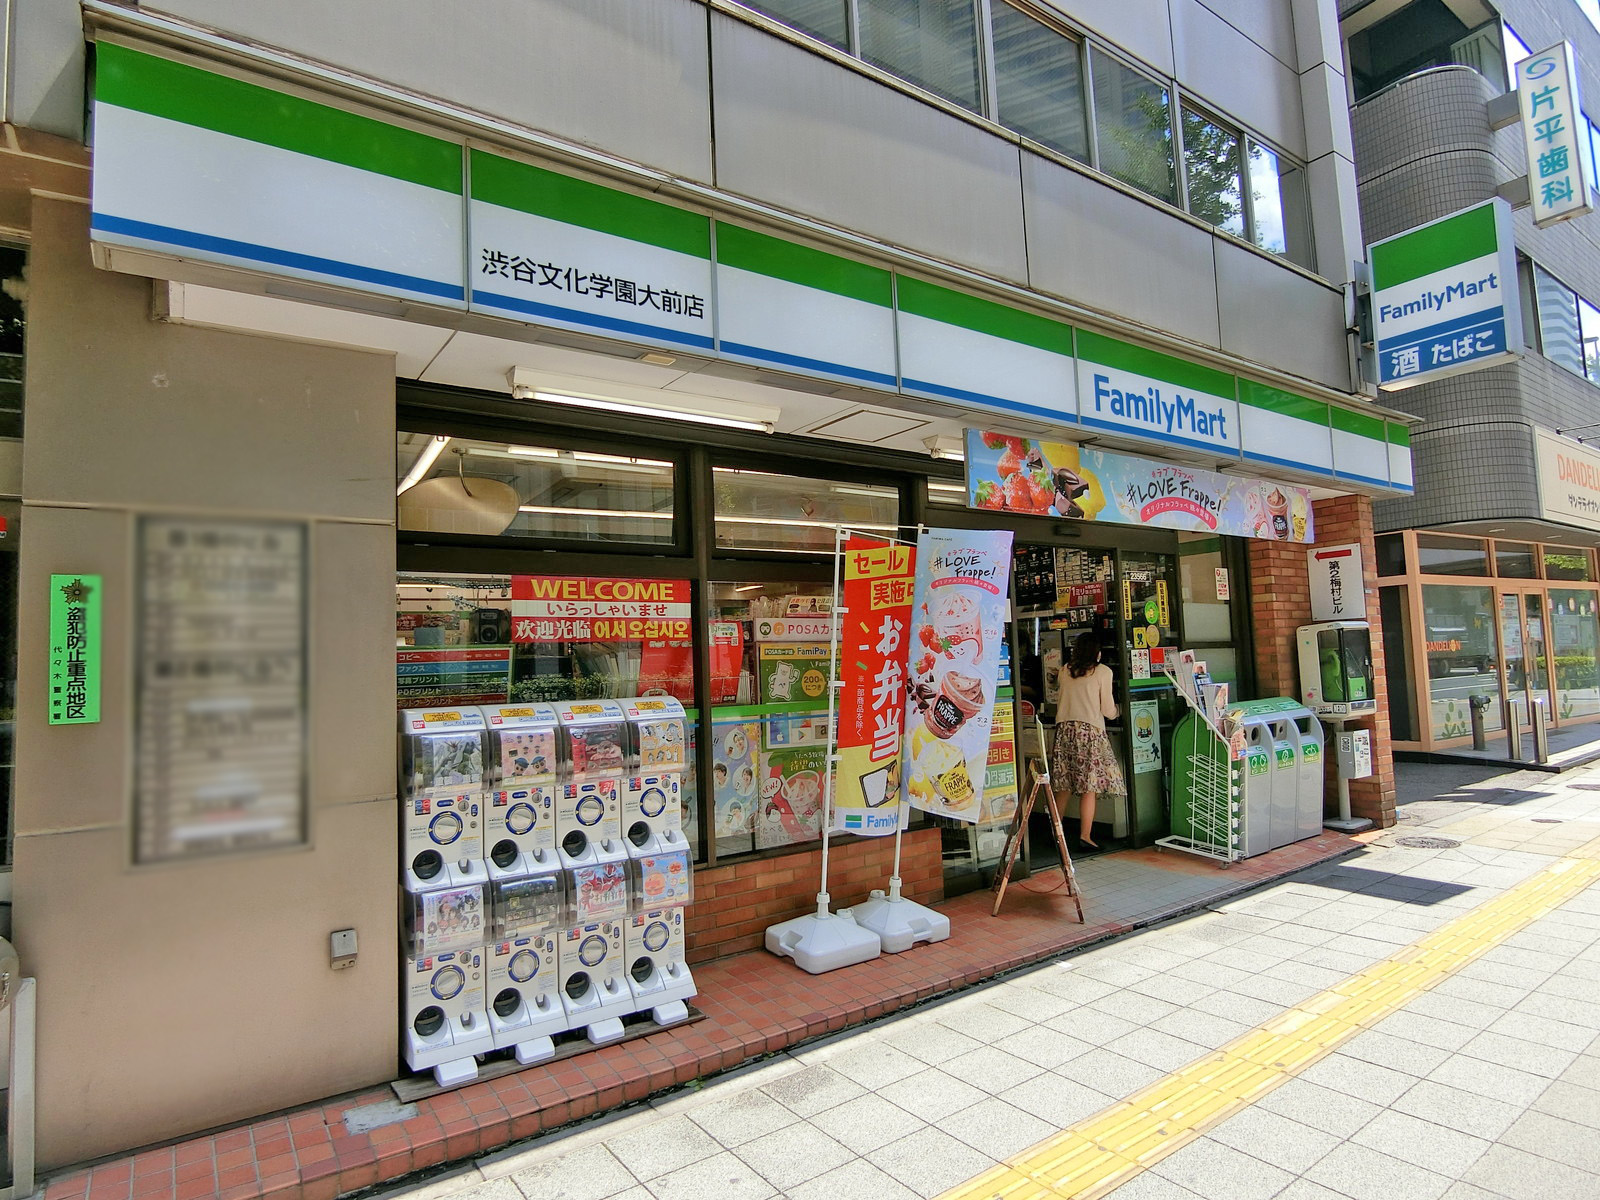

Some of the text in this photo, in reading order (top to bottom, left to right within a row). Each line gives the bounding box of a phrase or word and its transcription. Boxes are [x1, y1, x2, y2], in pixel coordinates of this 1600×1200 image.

[1530, 85, 1574, 209] 片平歯科
[481, 248, 704, 320] 渋谷文化学園大前店
[1379, 272, 1498, 323] FamilyMart
[1391, 330, 1496, 377] 酒 たばこ
[1094, 373, 1227, 440] FamilyMart
[853, 550, 905, 575] セール
[955, 566, 997, 580] Frappe!
[530, 579, 674, 601] WELCOME
[1328, 560, 1344, 615] 第2梅村ビル
[546, 603, 668, 617] いらっしゃいませ
[515, 619, 592, 640] 欢迎光临
[594, 621, 689, 640] 어서 오십시오
[66, 607, 87, 719] 盗犯防止重点地区
[398, 653, 421, 661] コピー
[797, 647, 827, 656] FamiPay
[872, 615, 904, 760] お弁当
